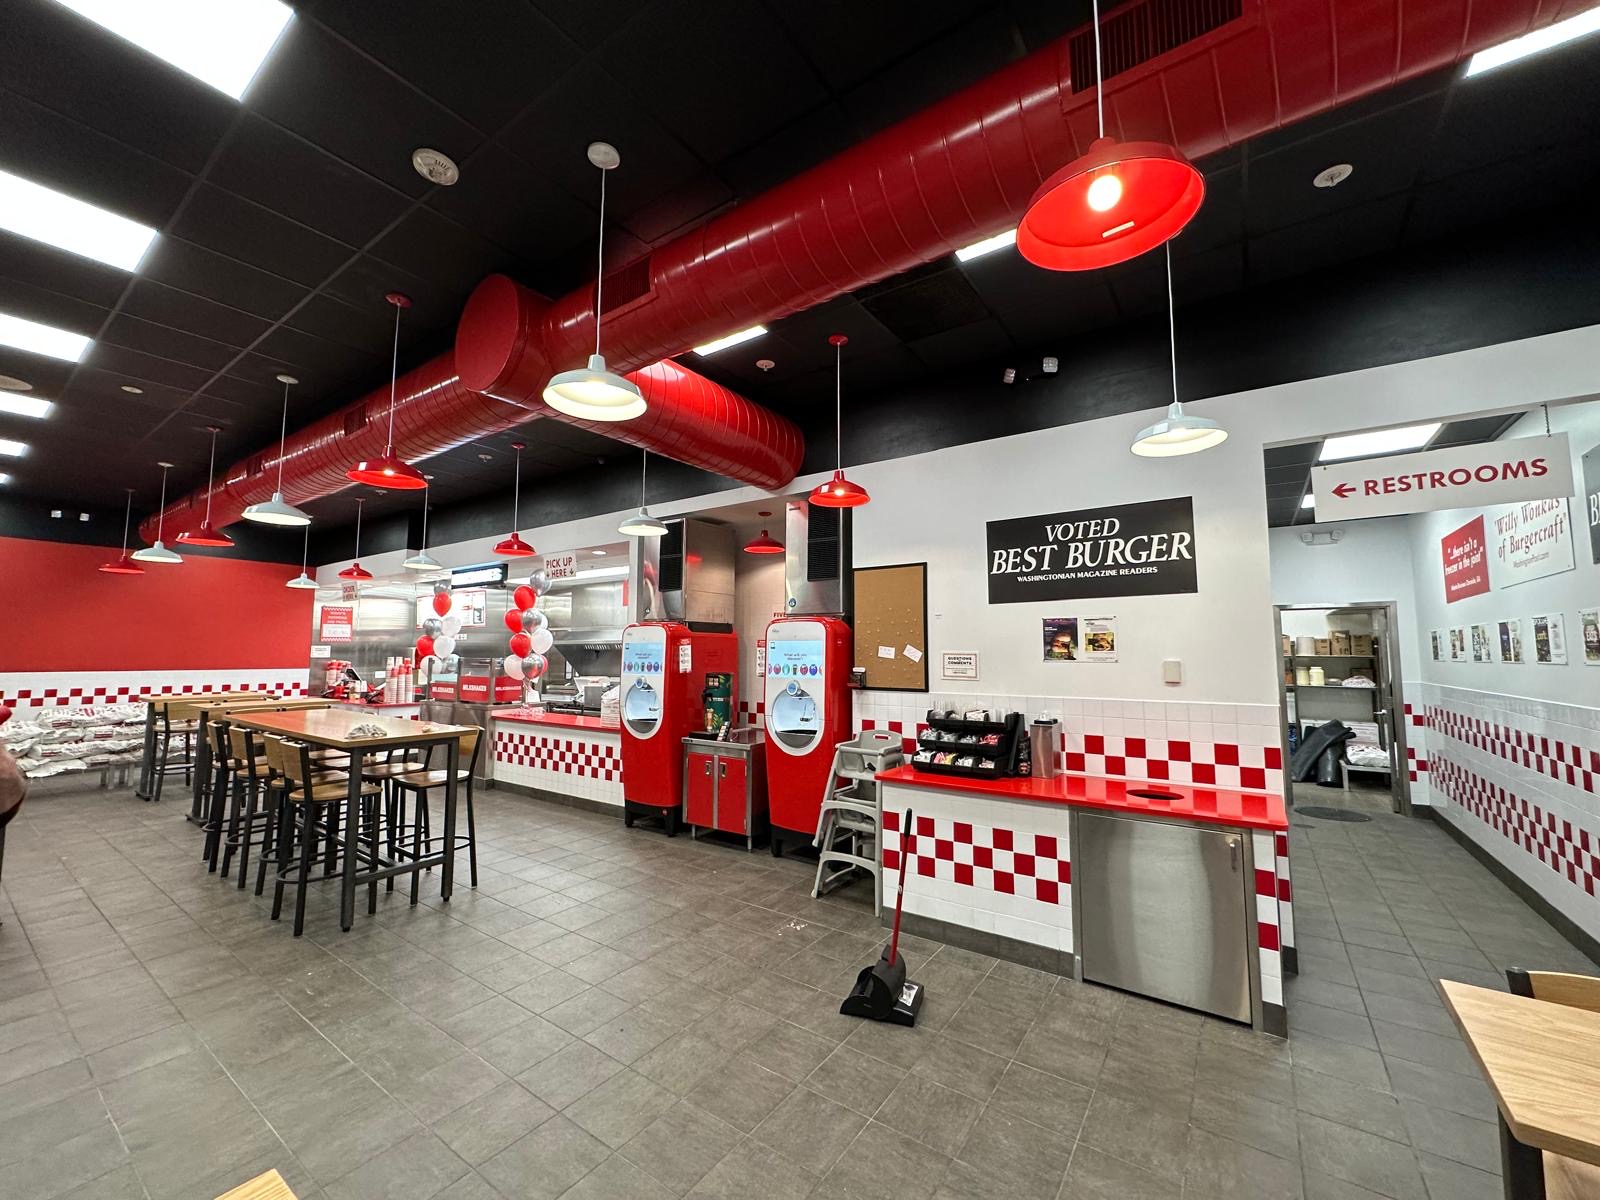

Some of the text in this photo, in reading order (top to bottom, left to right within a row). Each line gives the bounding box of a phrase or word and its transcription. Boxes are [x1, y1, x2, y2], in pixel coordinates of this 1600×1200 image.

[1363, 458, 1548, 497] RESTROOMS
[1045, 517, 1120, 543] VOTED
[546, 556, 573, 569] PICK UP
[990, 531, 1193, 575] BEST BURGER
[1498, 537, 1507, 563] of
[551, 568, 567, 578] HERE
[1016, 566, 1158, 583] WASHINGTONIAN MAGAZINE READERS
